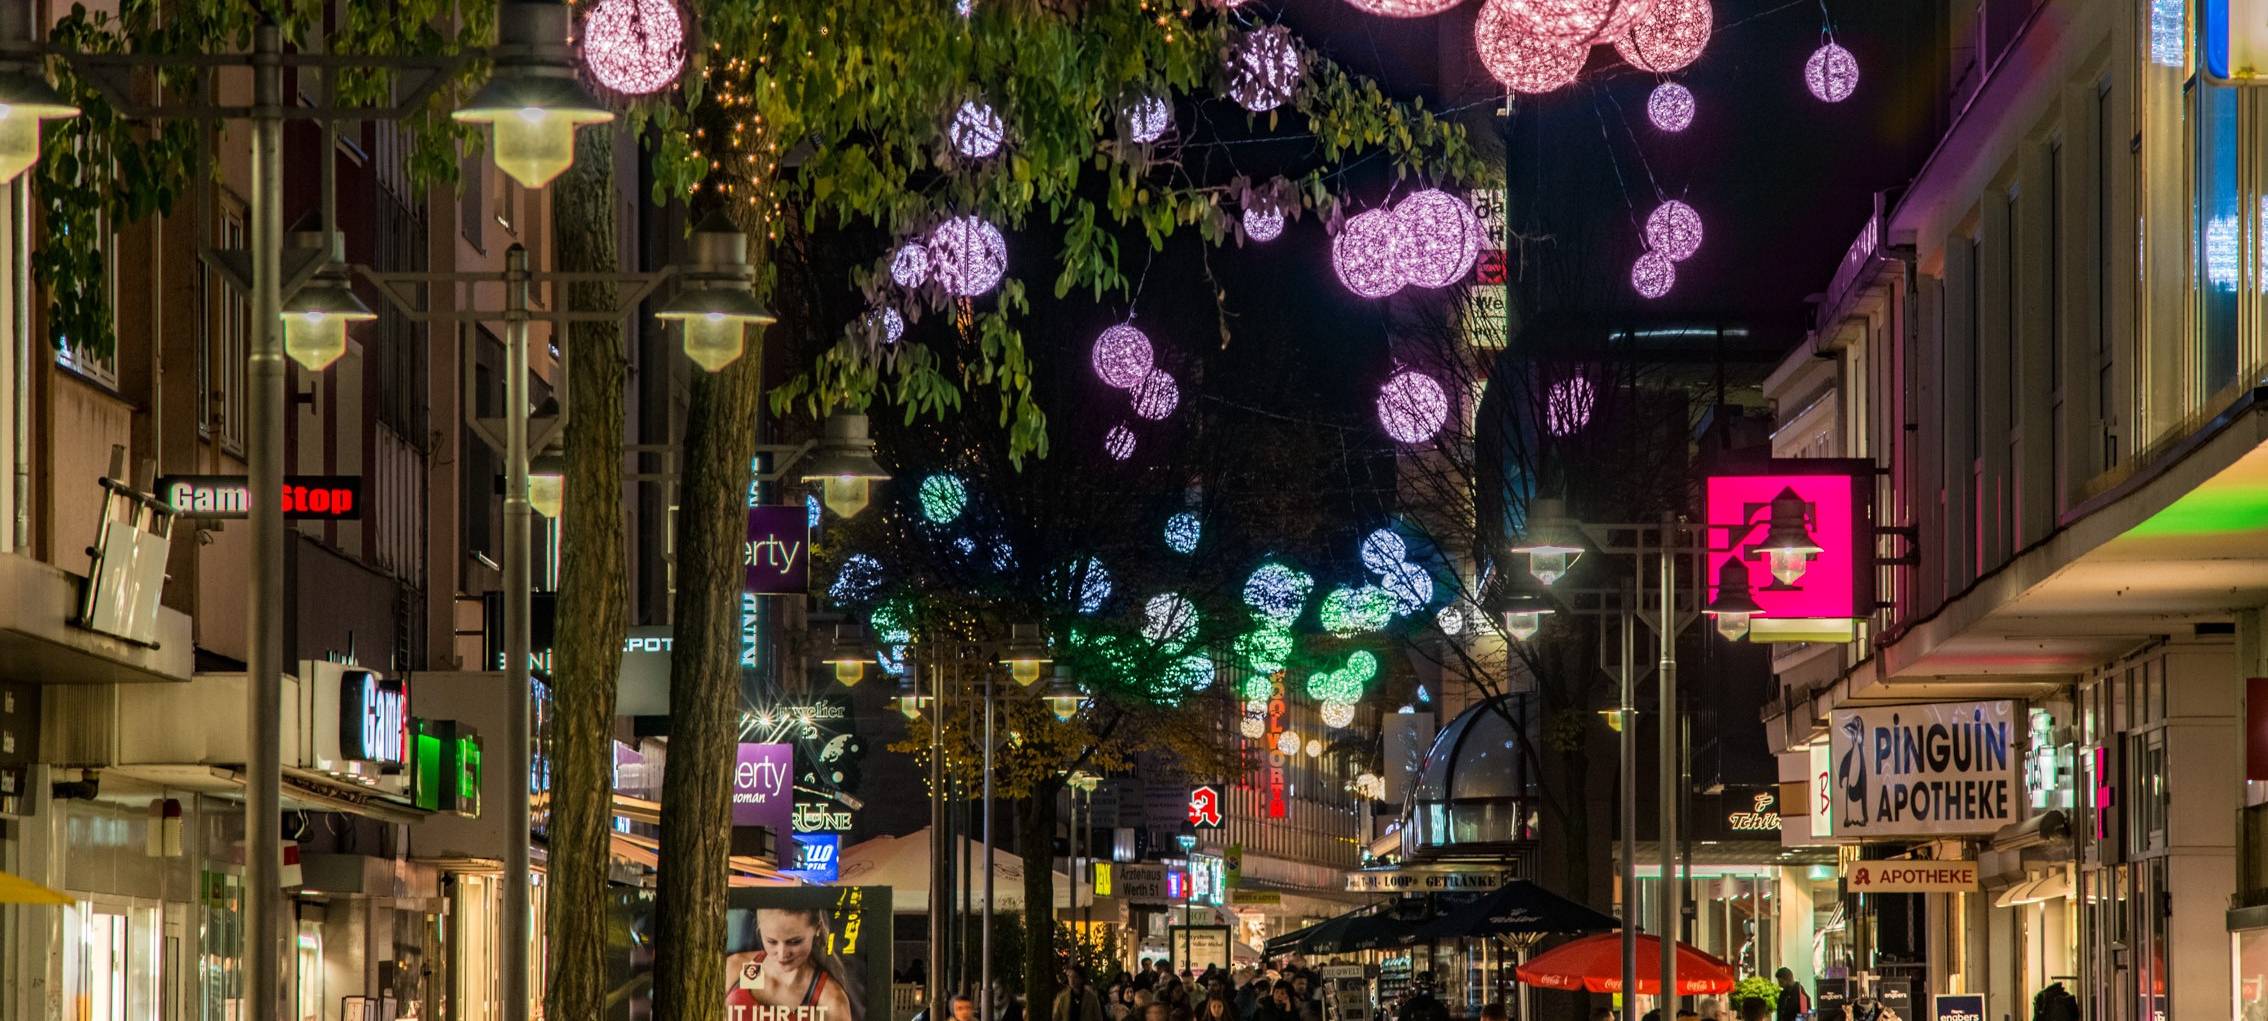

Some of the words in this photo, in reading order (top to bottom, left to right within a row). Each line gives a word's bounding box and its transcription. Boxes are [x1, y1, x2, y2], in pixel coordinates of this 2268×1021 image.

[171, 482, 352, 514] GamStop
[623, 638, 674, 652] POT
[734, 755, 787, 796] erty
[1876, 779, 2008, 823] APOTHEKE
[803, 845, 834, 862] LLO
[803, 863, 827, 871] PTIK
[1425, 873, 1497, 888] GETRÄNKE
[1880, 869, 1973, 885] APOTHEKE
[752, 1005, 791, 1021] IHR
[796, 1005, 829, 1021] FIT
